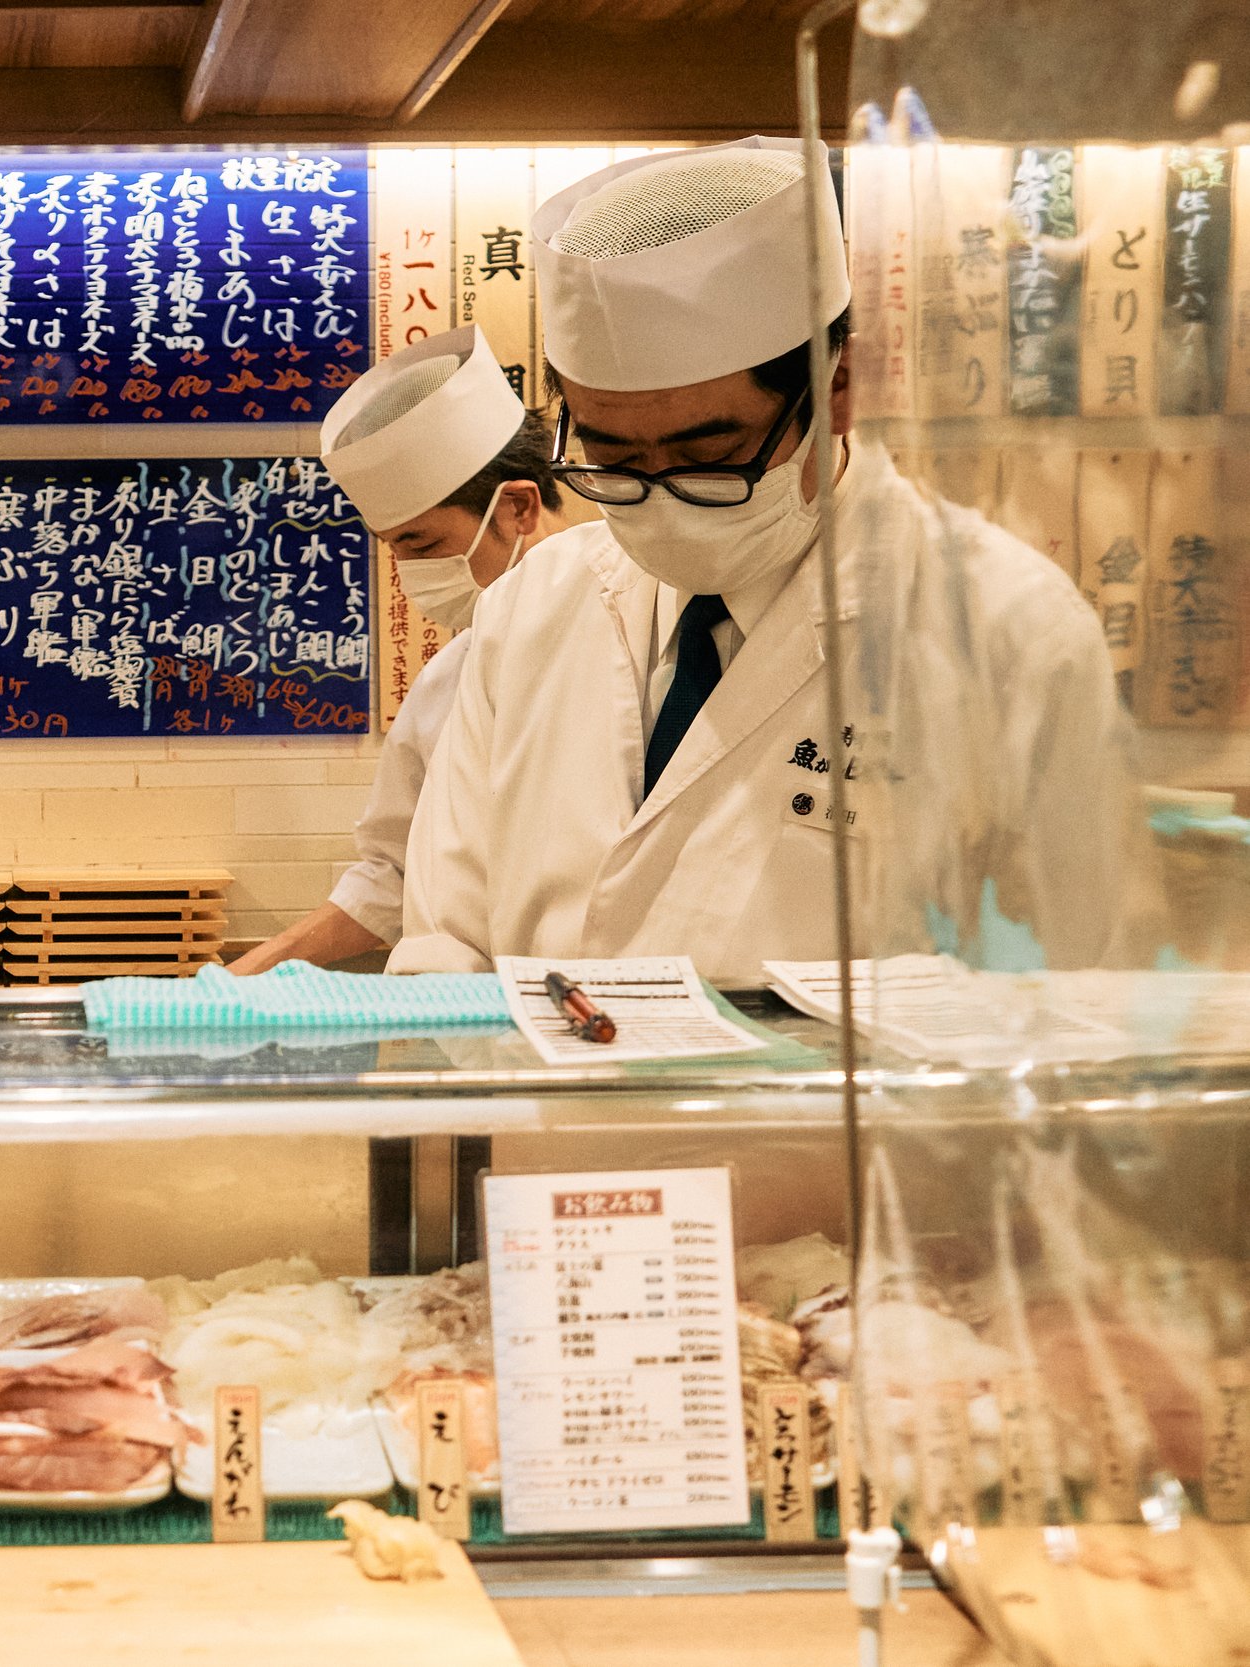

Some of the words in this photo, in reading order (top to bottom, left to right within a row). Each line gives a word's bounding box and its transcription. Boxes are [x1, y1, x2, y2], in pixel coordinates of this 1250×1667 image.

[217, 203, 257, 348] しまあじ
[463, 255, 476, 286] Red
[463, 292, 476, 322] Sea
[146, 486, 187, 646] 生さば
[178, 477, 227, 671] 金目鯛
